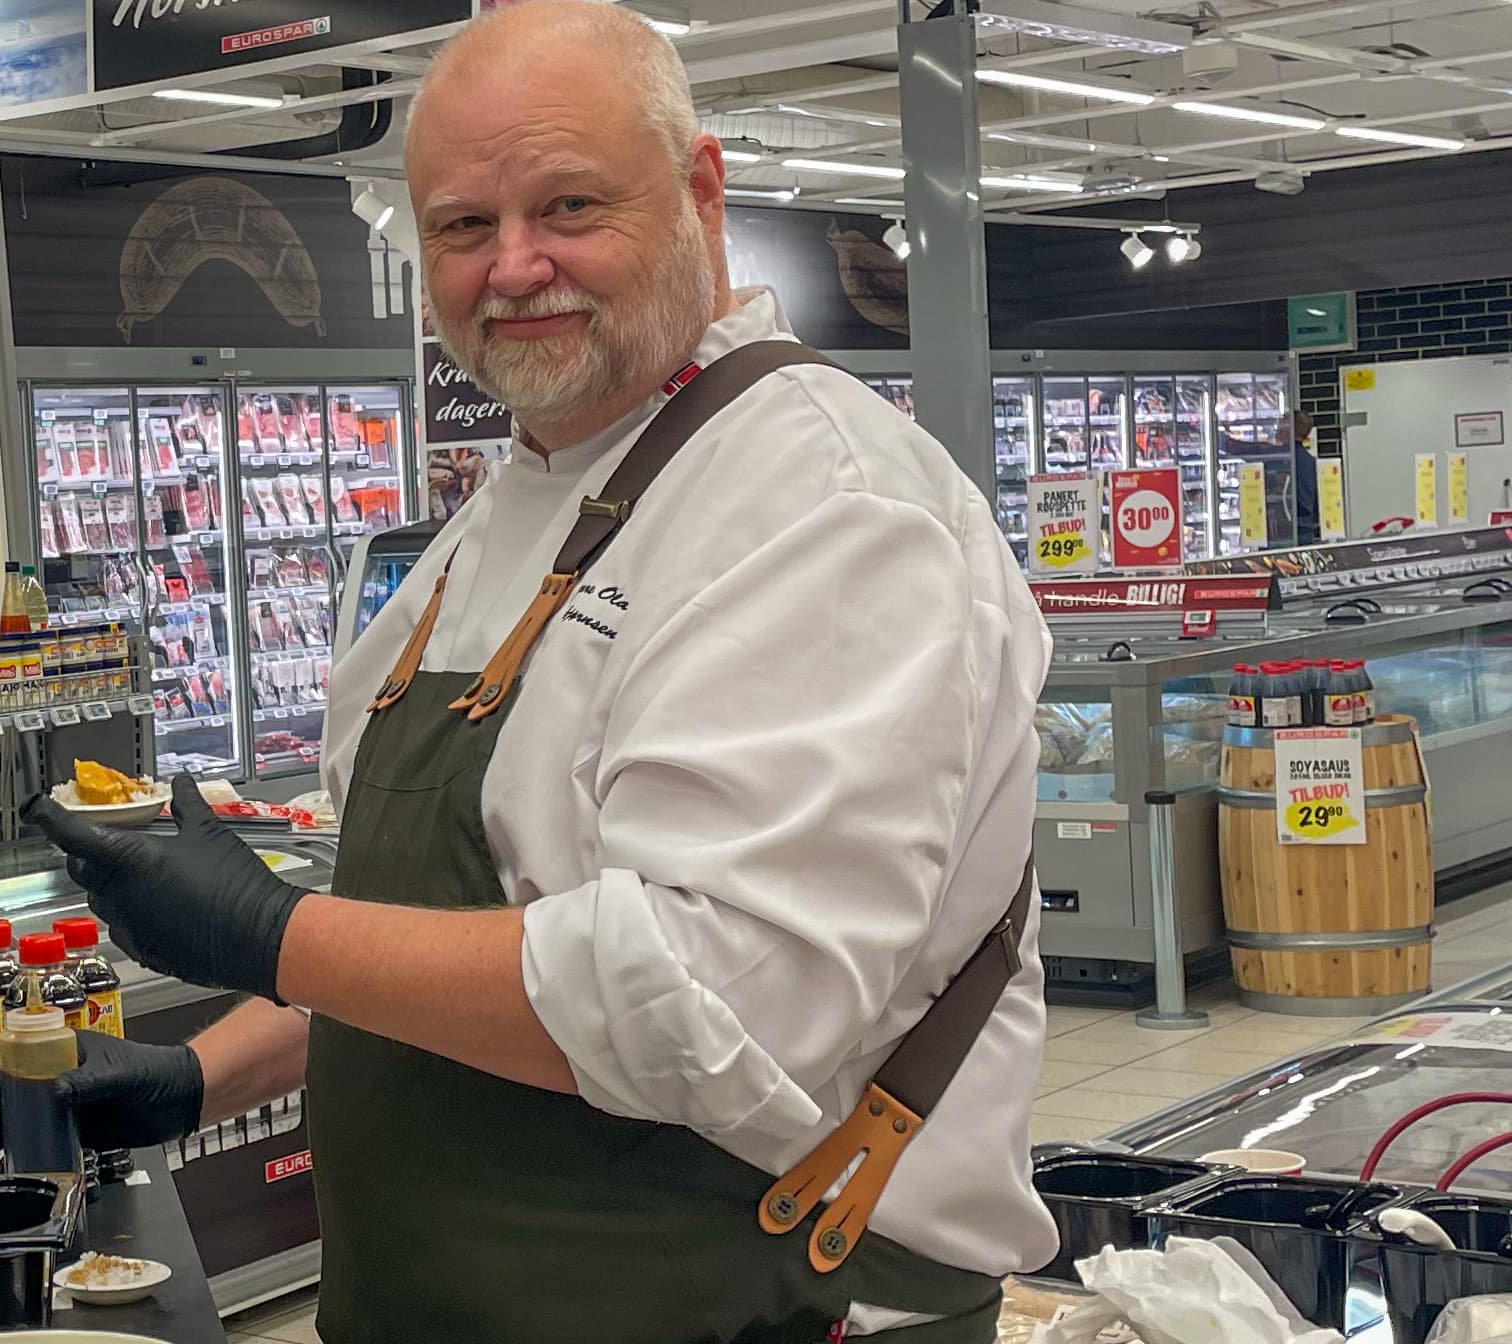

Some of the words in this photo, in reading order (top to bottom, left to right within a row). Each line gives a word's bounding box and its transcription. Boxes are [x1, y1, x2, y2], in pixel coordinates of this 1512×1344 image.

[231, 22, 313, 49] EUROSPAR
[1040, 518, 1087, 537] TILBUD!
[598, 587, 630, 610] Ola
[1126, 584, 1186, 606] BILLIG!
[1290, 760, 1349, 773] SOYASAUS
[1289, 783, 1350, 803] TILBUD!
